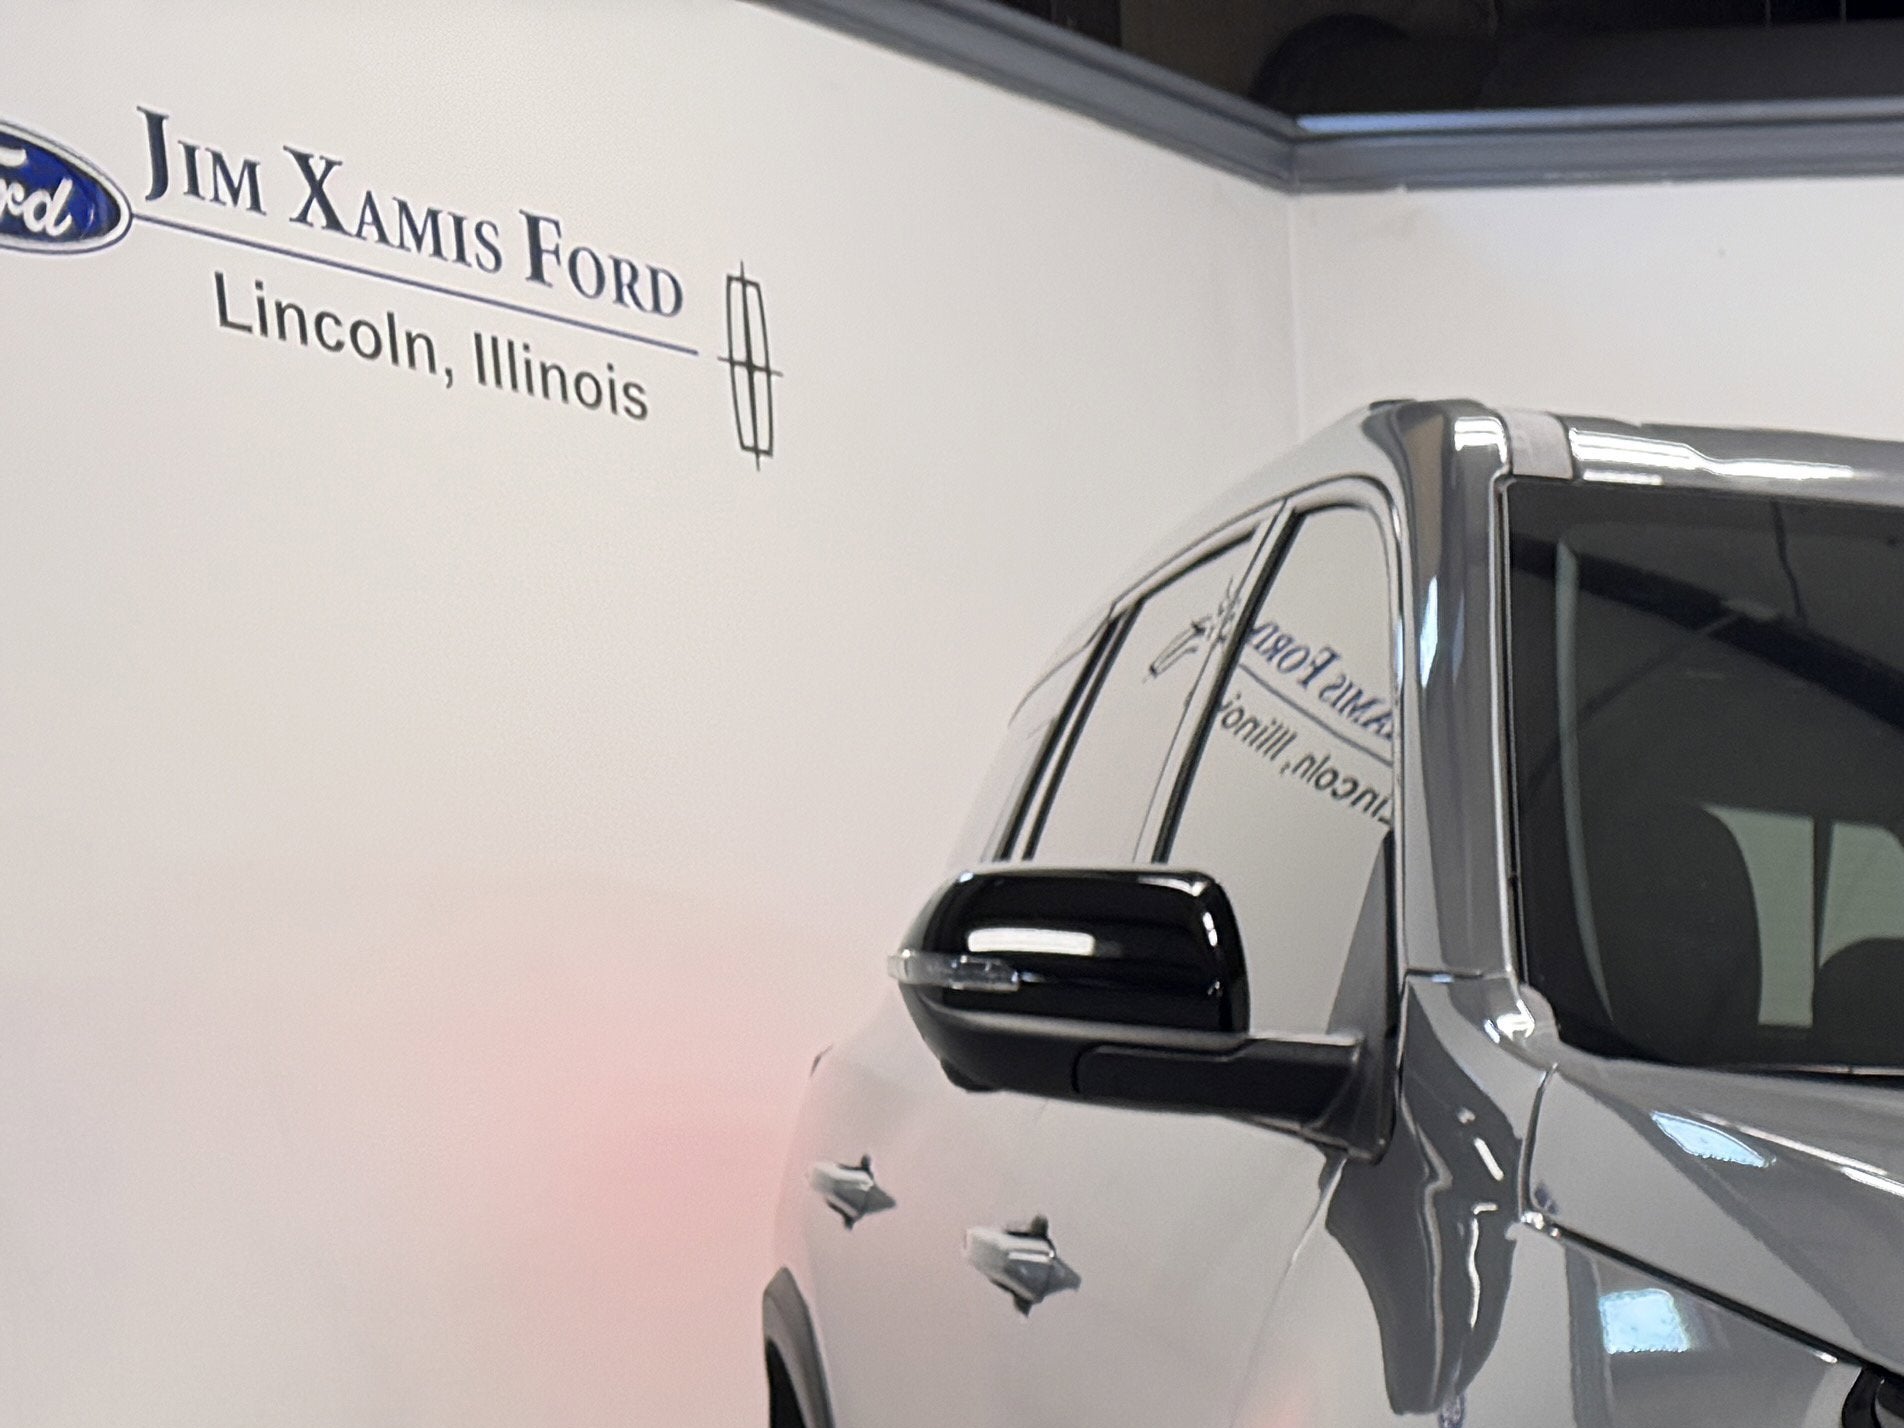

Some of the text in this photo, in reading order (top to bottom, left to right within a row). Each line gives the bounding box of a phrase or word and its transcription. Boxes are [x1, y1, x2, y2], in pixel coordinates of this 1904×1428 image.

[0, 147, 76, 239] rd
[136, 105, 684, 319] JIM XAMIS FORD
[213, 271, 649, 421] Lincoln, Illinois
